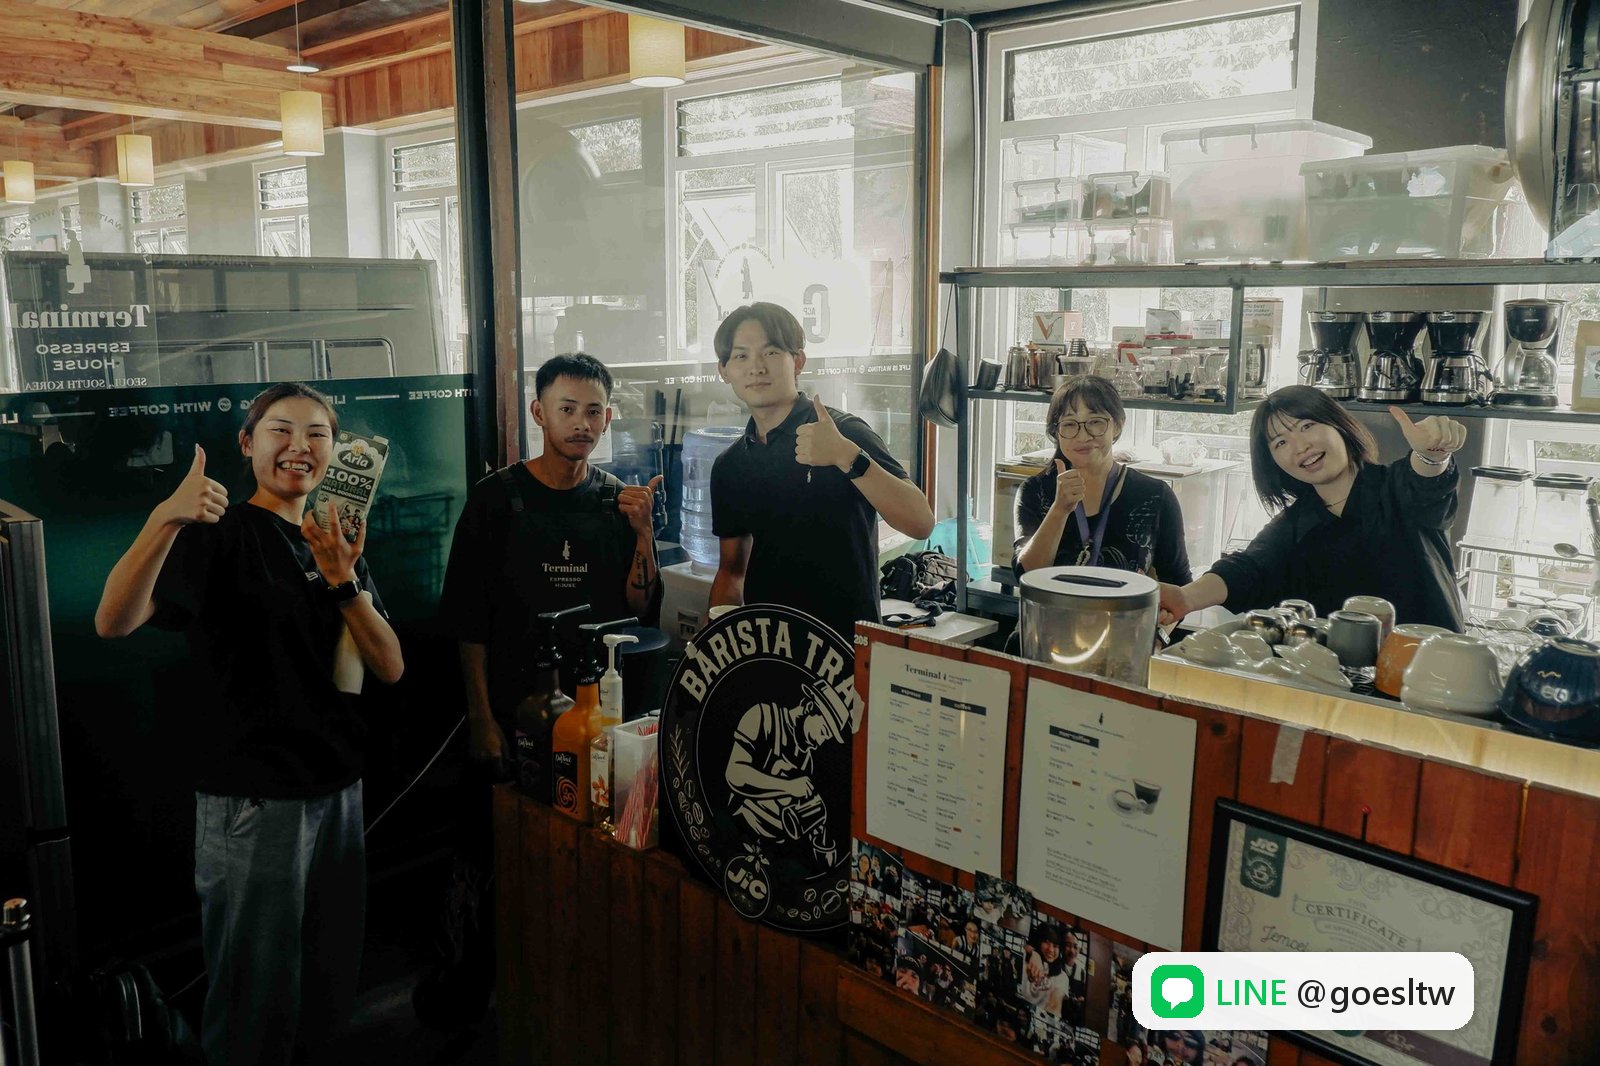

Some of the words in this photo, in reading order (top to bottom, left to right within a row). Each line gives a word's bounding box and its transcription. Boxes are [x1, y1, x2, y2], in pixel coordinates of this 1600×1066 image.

[342, 453, 368, 468] Arla
[325, 467, 373, 491] 100%
[321, 484, 337, 492] MILK
[323, 478, 368, 498] NATURAL
[337, 488, 368, 503] GOODNESS
[541, 563, 588, 573] Terminal
[853, 634, 869, 647] 205
[679, 617, 793, 703] BARISTA
[904, 663, 941, 681] Terminal
[1305, 903, 1409, 950] CERTIFICATE
